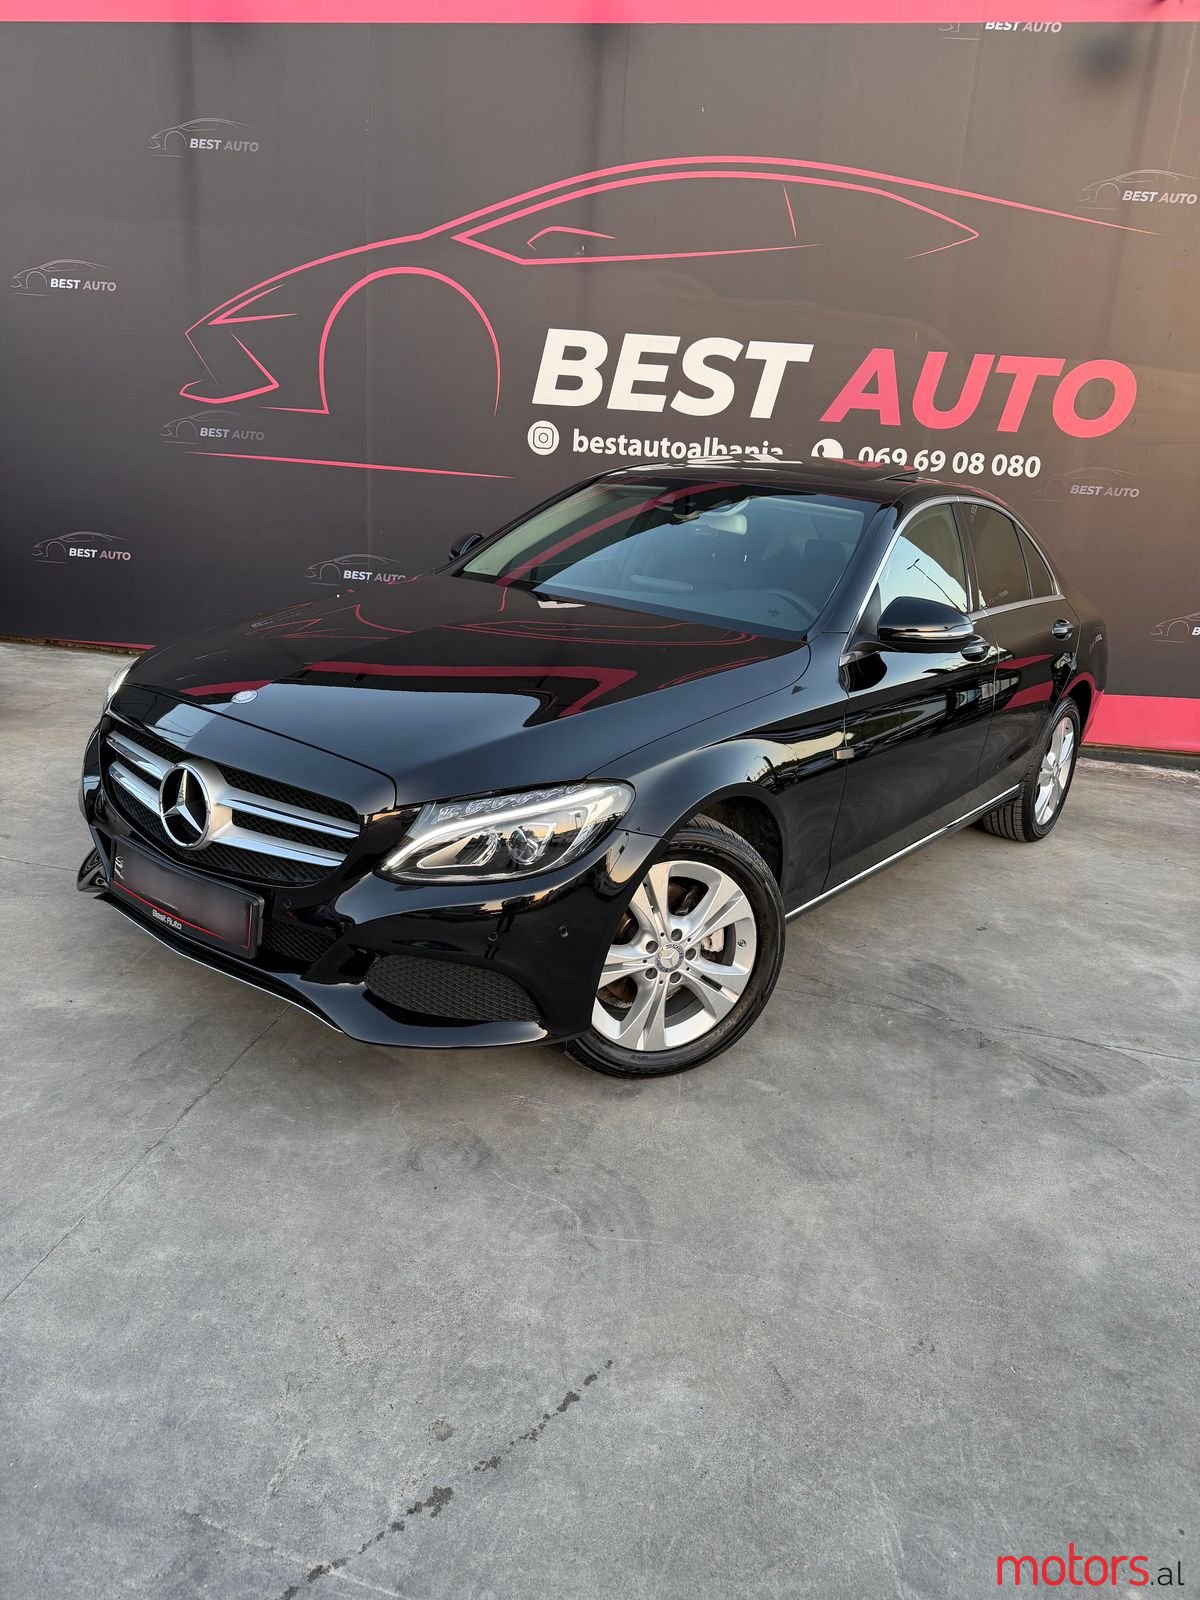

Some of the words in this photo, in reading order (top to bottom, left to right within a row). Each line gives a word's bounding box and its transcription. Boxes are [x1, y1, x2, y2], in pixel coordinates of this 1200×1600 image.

[985, 21, 1020, 31] BEST
[1022, 21, 1062, 33] AUTO
[190, 138, 222, 150] BEST
[224, 141, 259, 152] AUTO
[1122, 190, 1158, 203] BEST
[1159, 192, 1198, 205] AUTO
[50, 278, 81, 290] BEST
[83, 280, 117, 292] AUTO
[531, 328, 814, 419] BEST
[819, 347, 1137, 438] AUTO
[200, 427, 230, 438] BEST
[232, 430, 265, 441] AUTO
[857, 446, 908, 466] 069
[913, 449, 946, 472] 69
[952, 451, 985, 475] 08
[991, 453, 1041, 478] 080
[1069, 484, 1103, 496] BEST
[1104, 487, 1140, 499] AUTO
[69, 547, 98, 558] BEST
[99, 550, 131, 561] AUTO
[343, 570, 372, 581] BEST
[152, 909, 167, 923] Best
[167, 917, 182, 930] Auto
